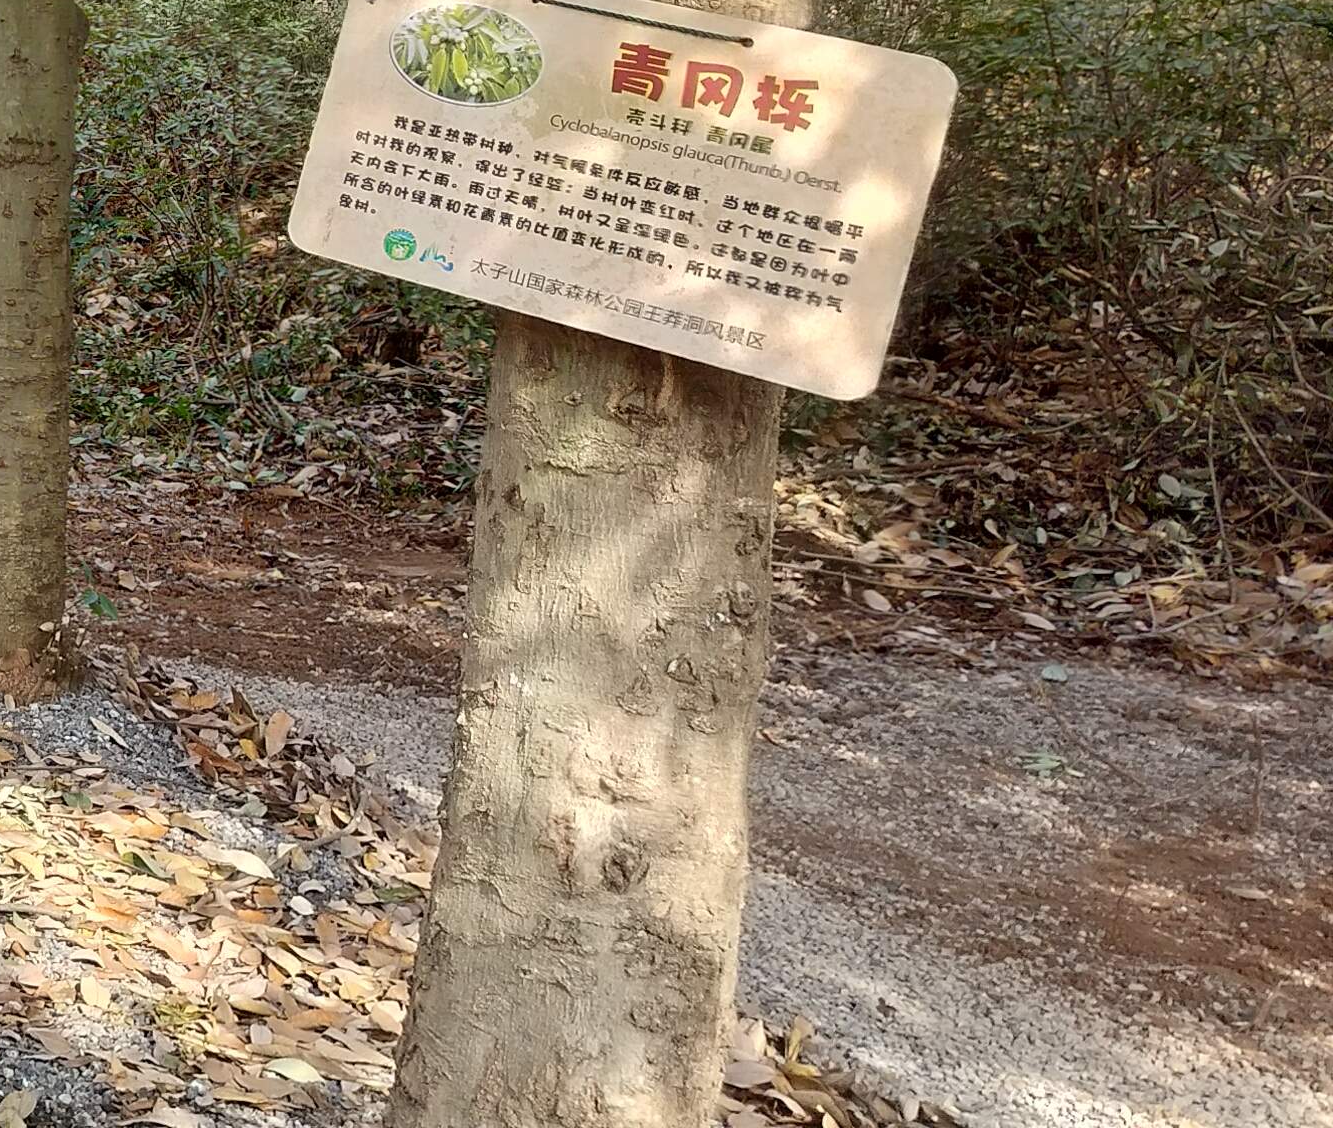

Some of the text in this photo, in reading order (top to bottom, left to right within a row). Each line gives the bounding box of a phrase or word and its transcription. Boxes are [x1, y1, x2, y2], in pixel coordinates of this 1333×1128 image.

[609, 41, 820, 133] 青冈栎
[548, 113, 671, 155] Cyclobalanopsis
[624, 106, 693, 137] 壳斗科
[469, 256, 767, 351] 太子山国家森林公园王莽洞风景区
